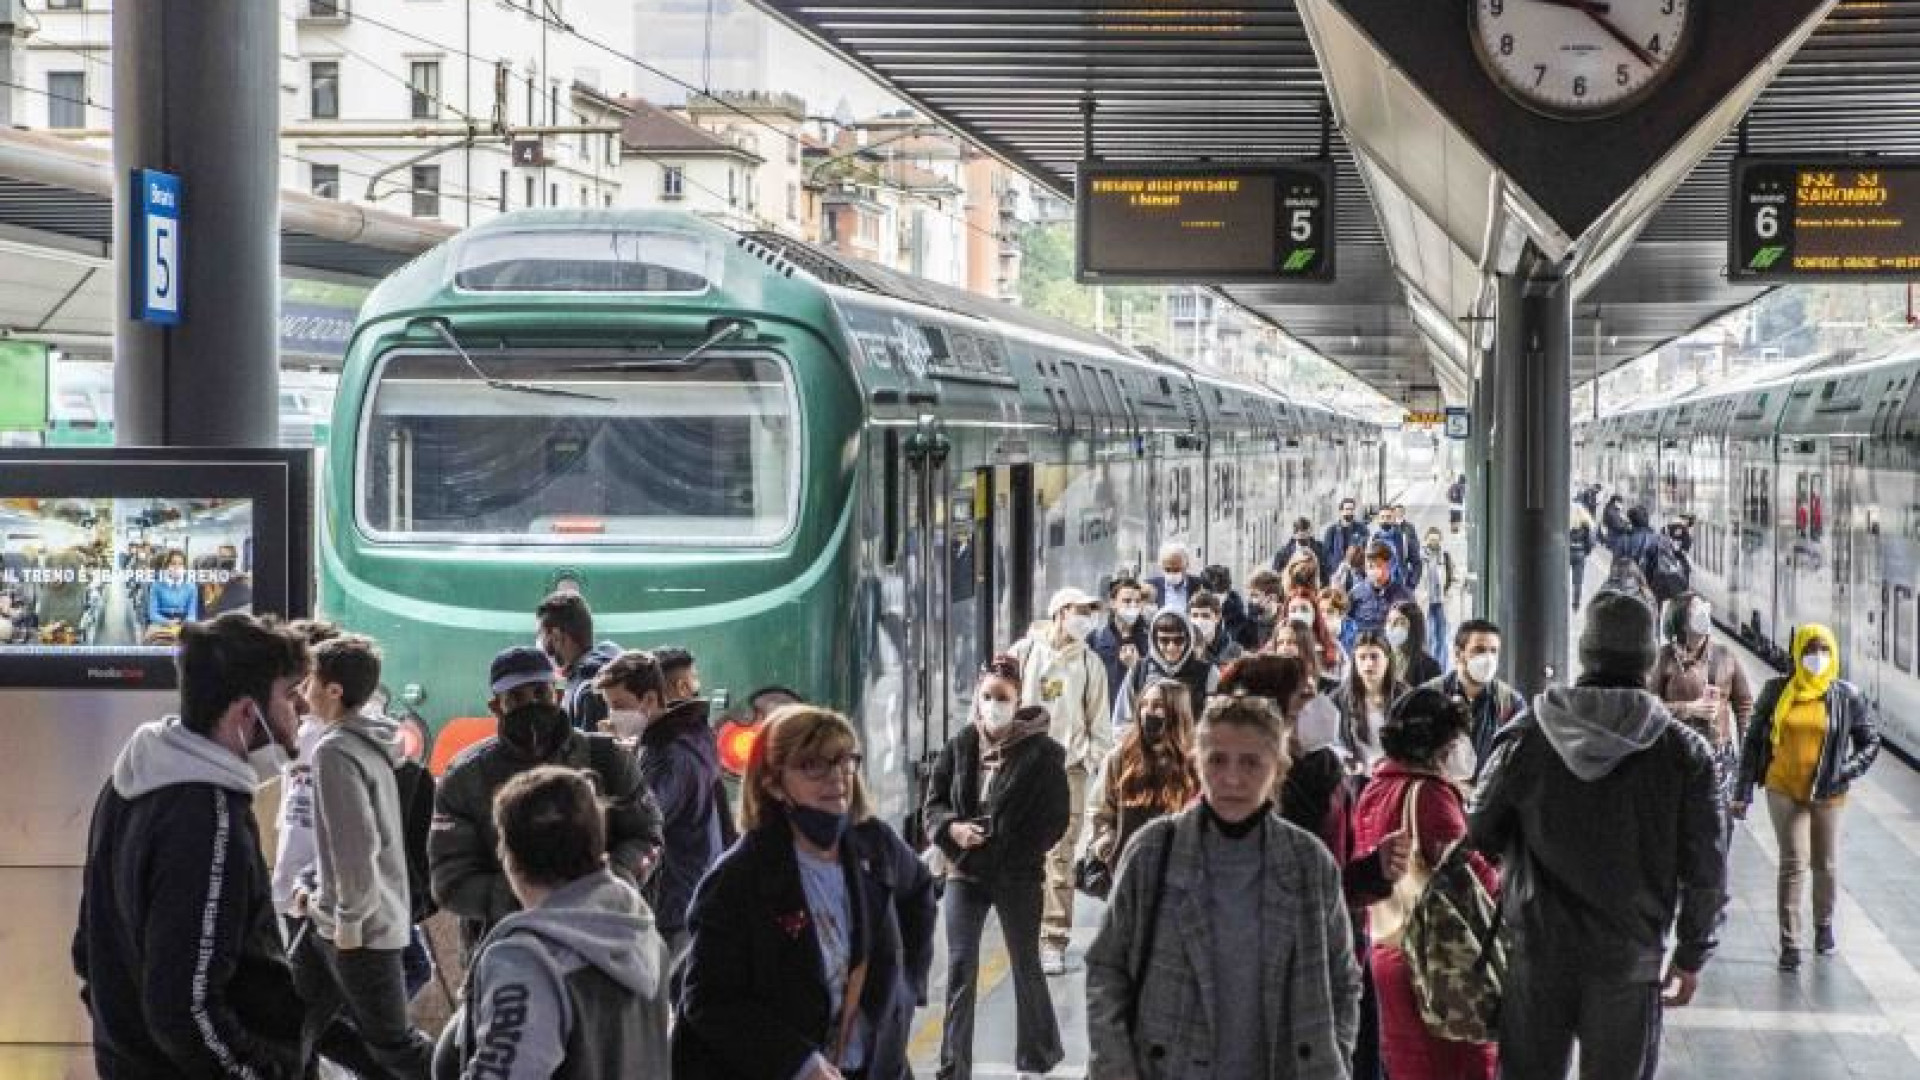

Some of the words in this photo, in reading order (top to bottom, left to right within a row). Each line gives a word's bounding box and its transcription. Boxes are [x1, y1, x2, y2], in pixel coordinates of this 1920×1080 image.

[1501, 34, 1514, 55] 8
[1649, 34, 1660, 53] 4
[1534, 65, 1547, 86] 7
[1574, 76, 1586, 96] 6
[1617, 65, 1629, 86] 5
[523, 147, 532, 162] 4
[1290, 210, 1312, 242] 5
[1756, 206, 1779, 239] 6
[156, 228, 170, 298] 5
[4, 570, 19, 583] IL
[23, 570, 75, 583] TRENO
[178, 570, 230, 583] TRENO
